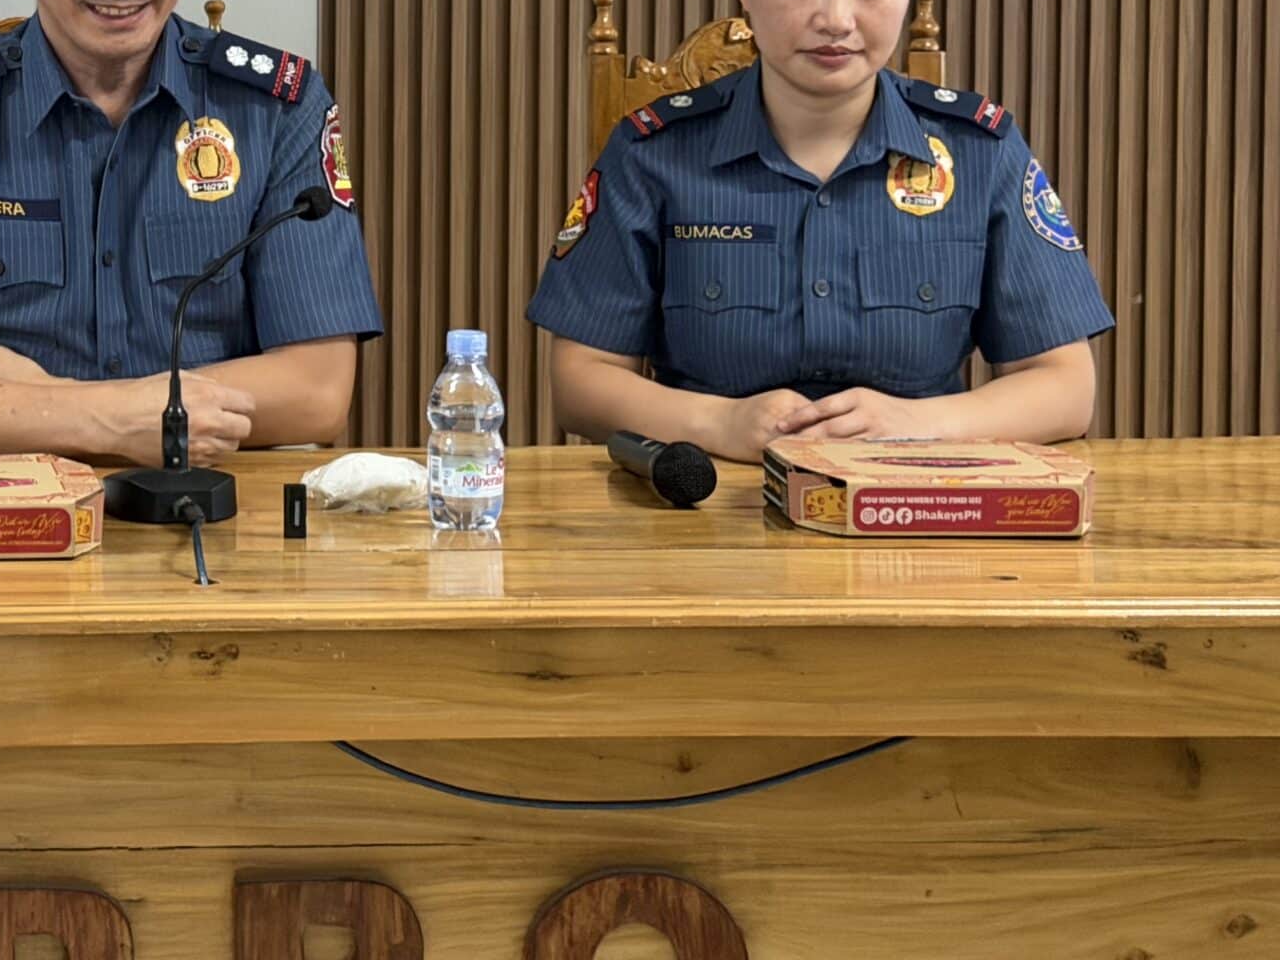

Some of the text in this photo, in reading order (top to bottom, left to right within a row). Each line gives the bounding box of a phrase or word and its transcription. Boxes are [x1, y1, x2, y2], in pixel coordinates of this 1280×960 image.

[283, 61, 297, 85] PNP
[674, 224, 753, 239] BUMACAS
[860, 496, 878, 504] YOU
[935, 496, 947, 504] TO
[914, 509, 982, 522] ShakeysPH
